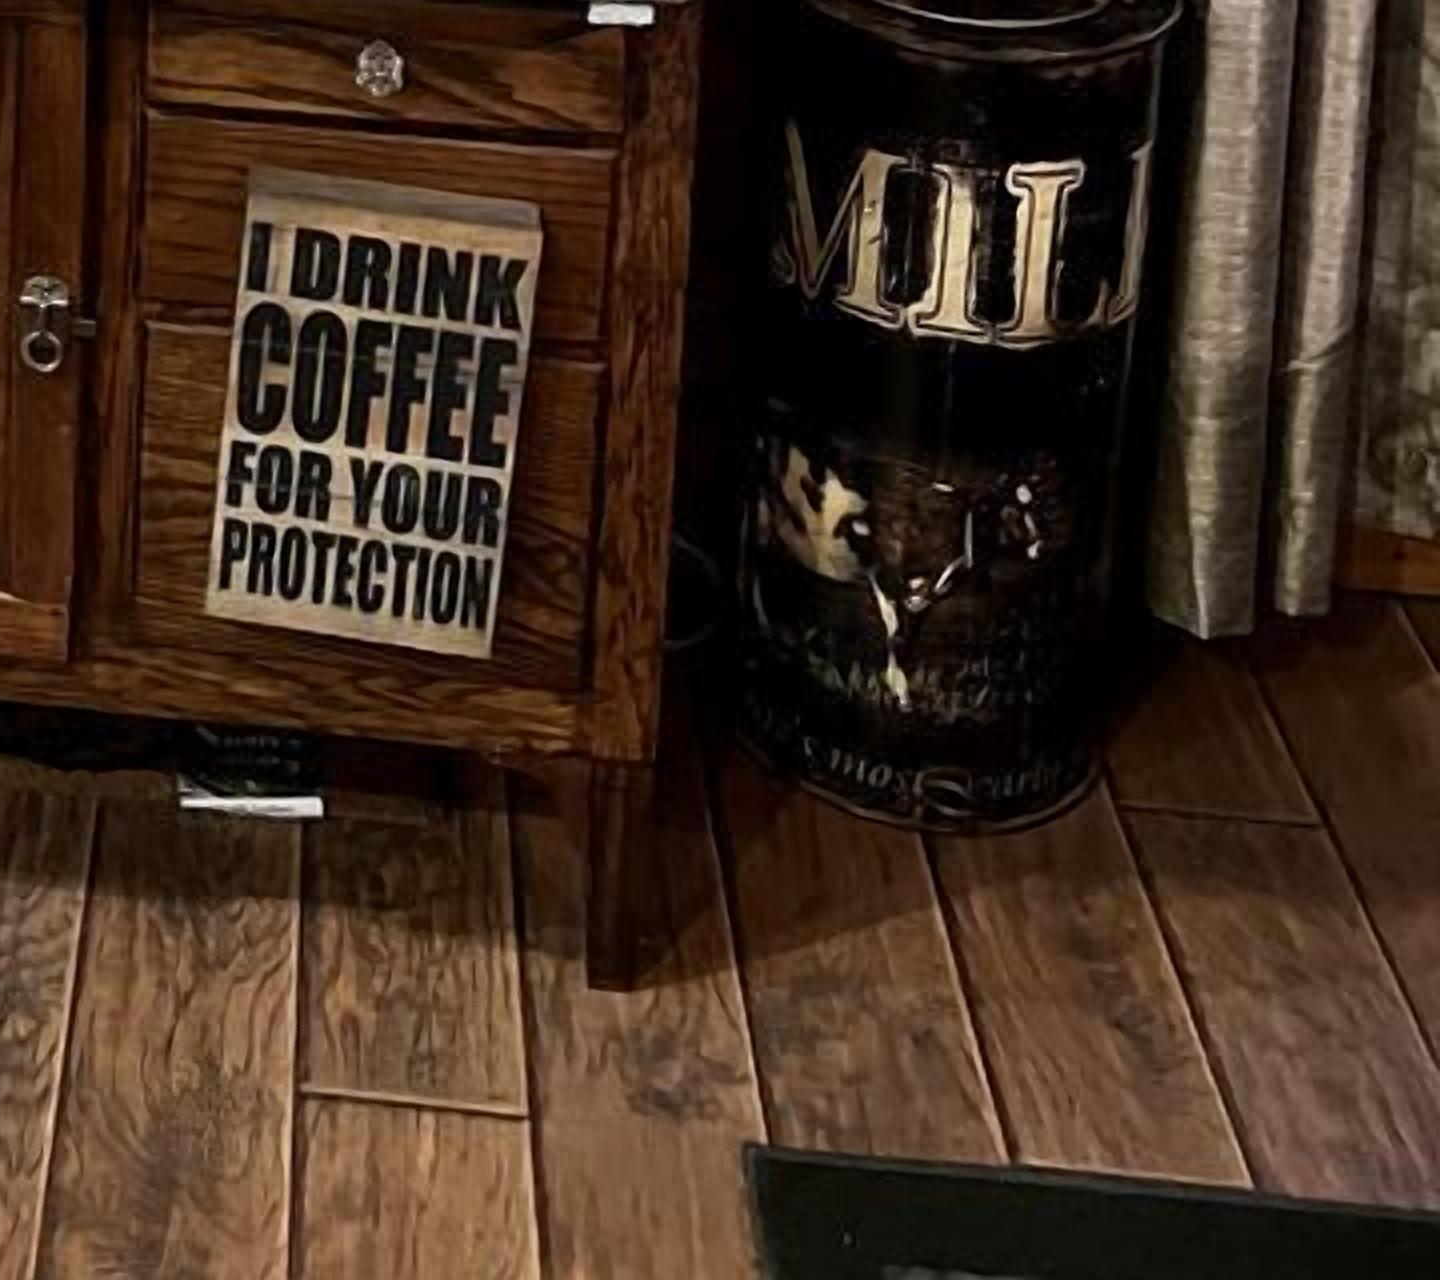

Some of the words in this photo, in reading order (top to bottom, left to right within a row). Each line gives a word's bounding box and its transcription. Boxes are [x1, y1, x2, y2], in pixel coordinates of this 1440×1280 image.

[246, 221, 273, 292] I
[290, 227, 527, 332] DRINK
[236, 301, 519, 469] COFFEE
[225, 440, 333, 523] FOR
[349, 456, 504, 548] YOUR
[218, 517, 494, 631] PROTECTION
